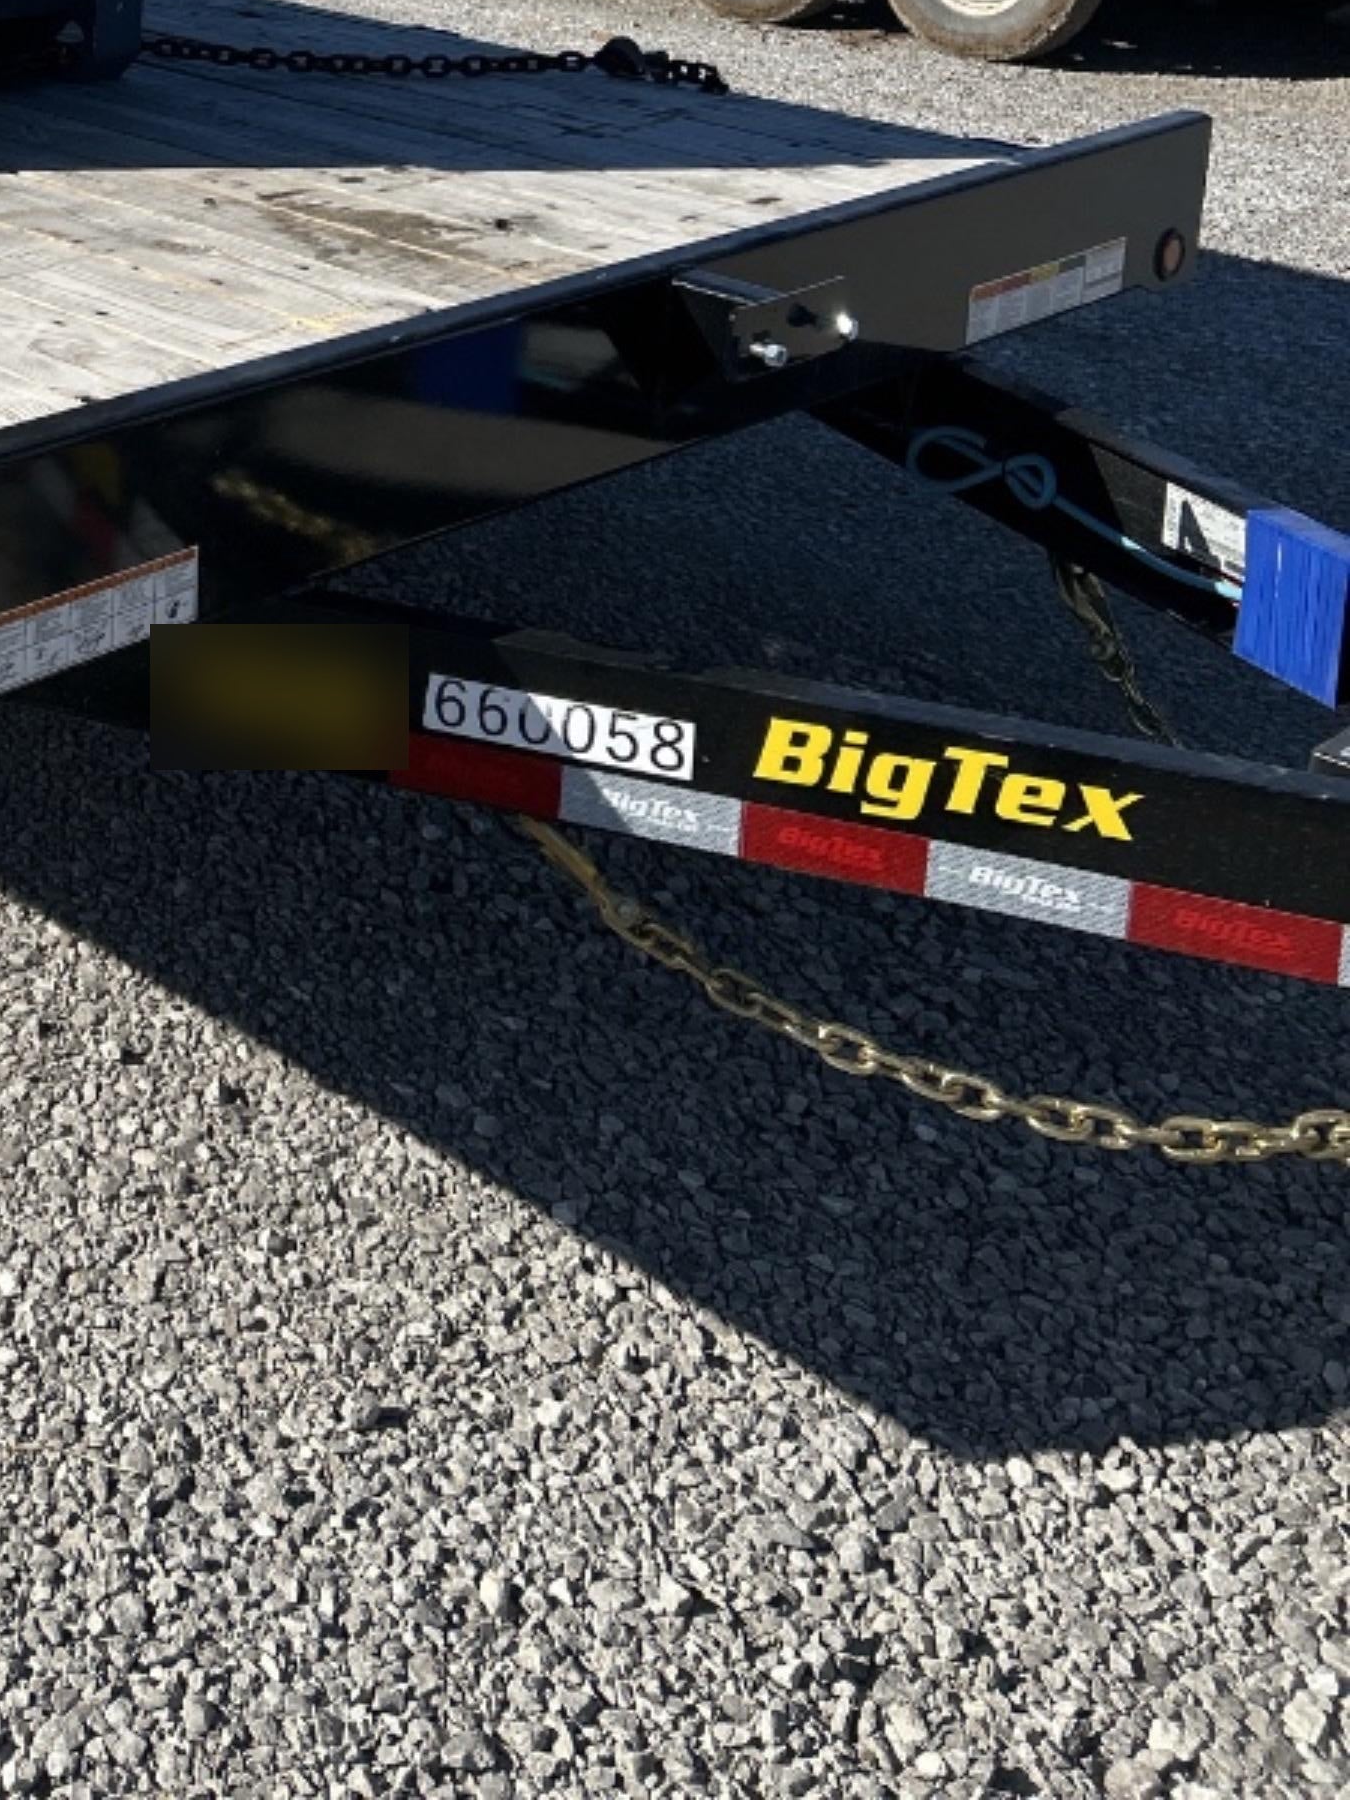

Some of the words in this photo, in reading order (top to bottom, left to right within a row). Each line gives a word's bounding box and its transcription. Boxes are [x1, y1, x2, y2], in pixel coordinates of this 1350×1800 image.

[434, 679, 685, 771] 660058
[753, 717, 1144, 842] BigTex
[776, 826, 883, 865] BigTex
[967, 865, 1082, 904] BigTex
[1172, 908, 1292, 950] BigTex
